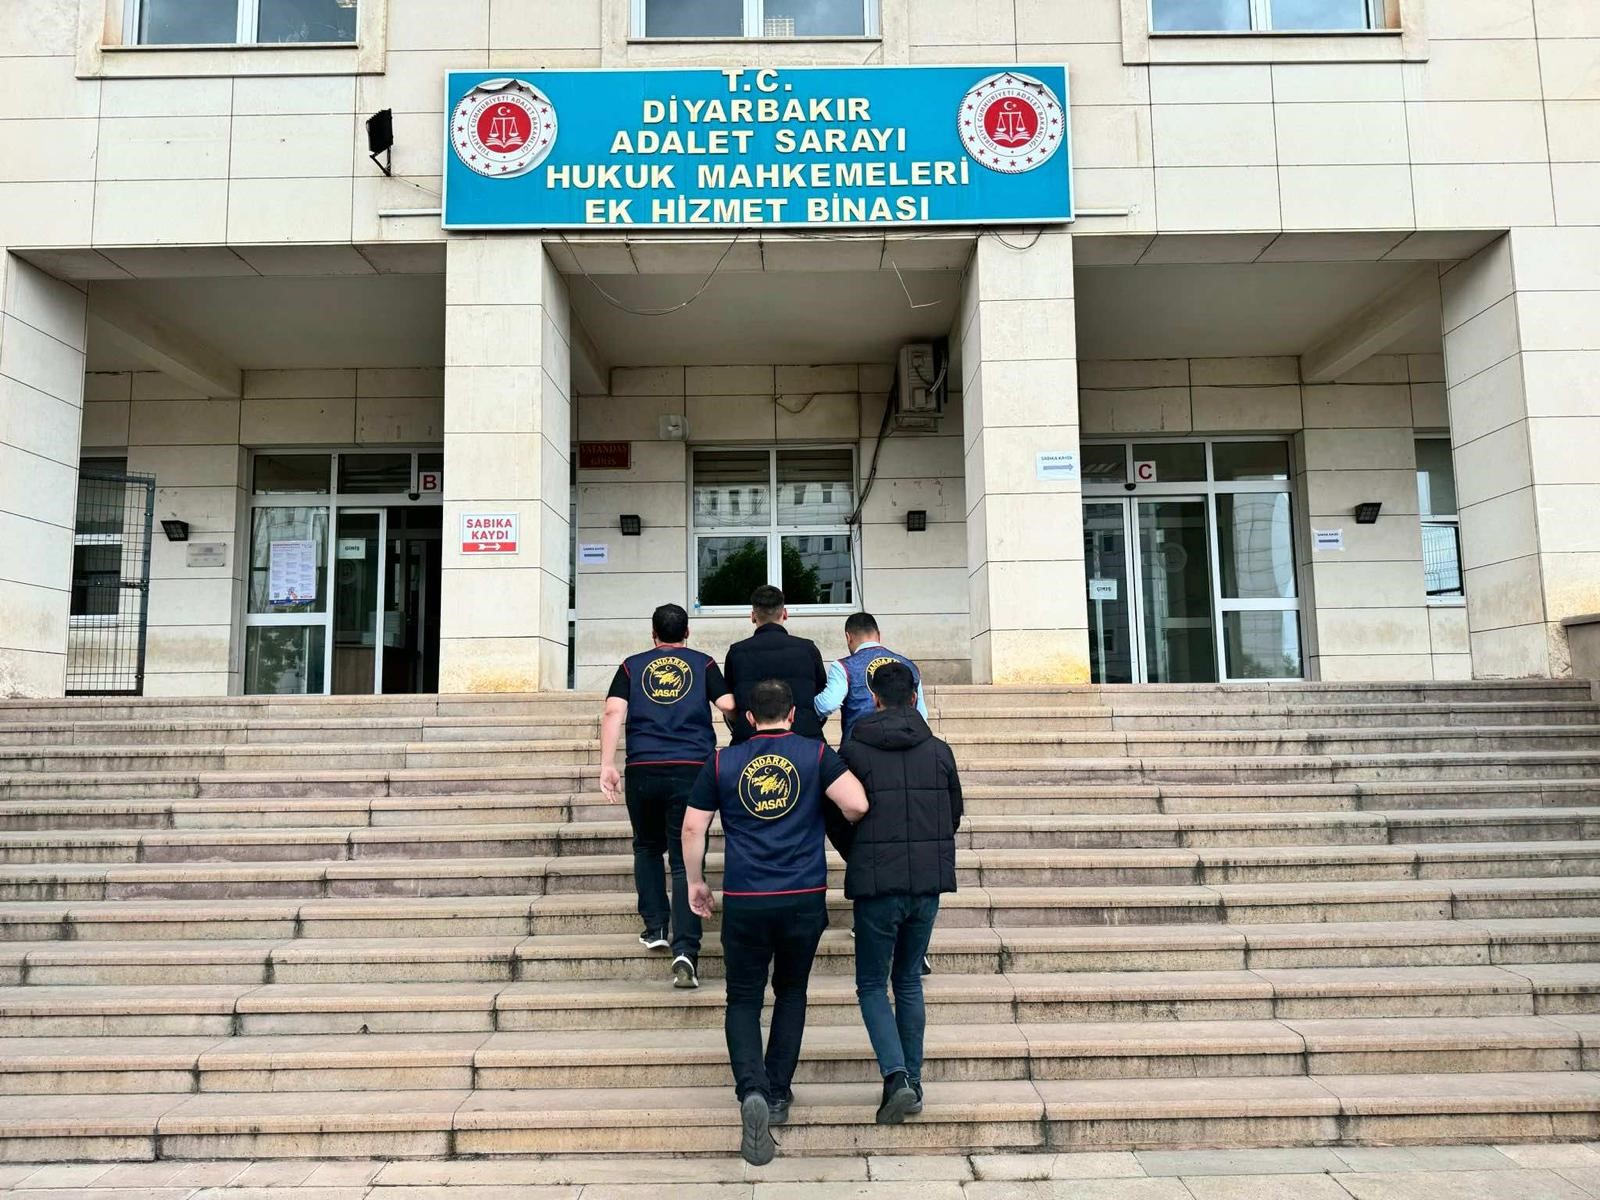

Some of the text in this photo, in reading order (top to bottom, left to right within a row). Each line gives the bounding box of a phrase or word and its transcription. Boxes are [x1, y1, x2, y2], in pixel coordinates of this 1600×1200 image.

[722, 69, 792, 92] T.C.
[511, 96, 535, 115] ADALET
[643, 95, 871, 123] DİYARBAKIR
[610, 128, 906, 154] ADALET SARAYI
[547, 156, 969, 189] HUKUK MAHKEMELERİ
[585, 192, 929, 223] EK HİZMET BİNASI
[1138, 463, 1153, 480] C
[423, 474, 437, 490] B
[466, 518, 513, 528] SABIKA
[471, 530, 509, 540] KAYDI
[649, 657, 689, 673] JANDARMA
[652, 689, 681, 697] JASAT
[744, 756, 793, 780] JANDARMA
[754, 797, 788, 811] JASAT
